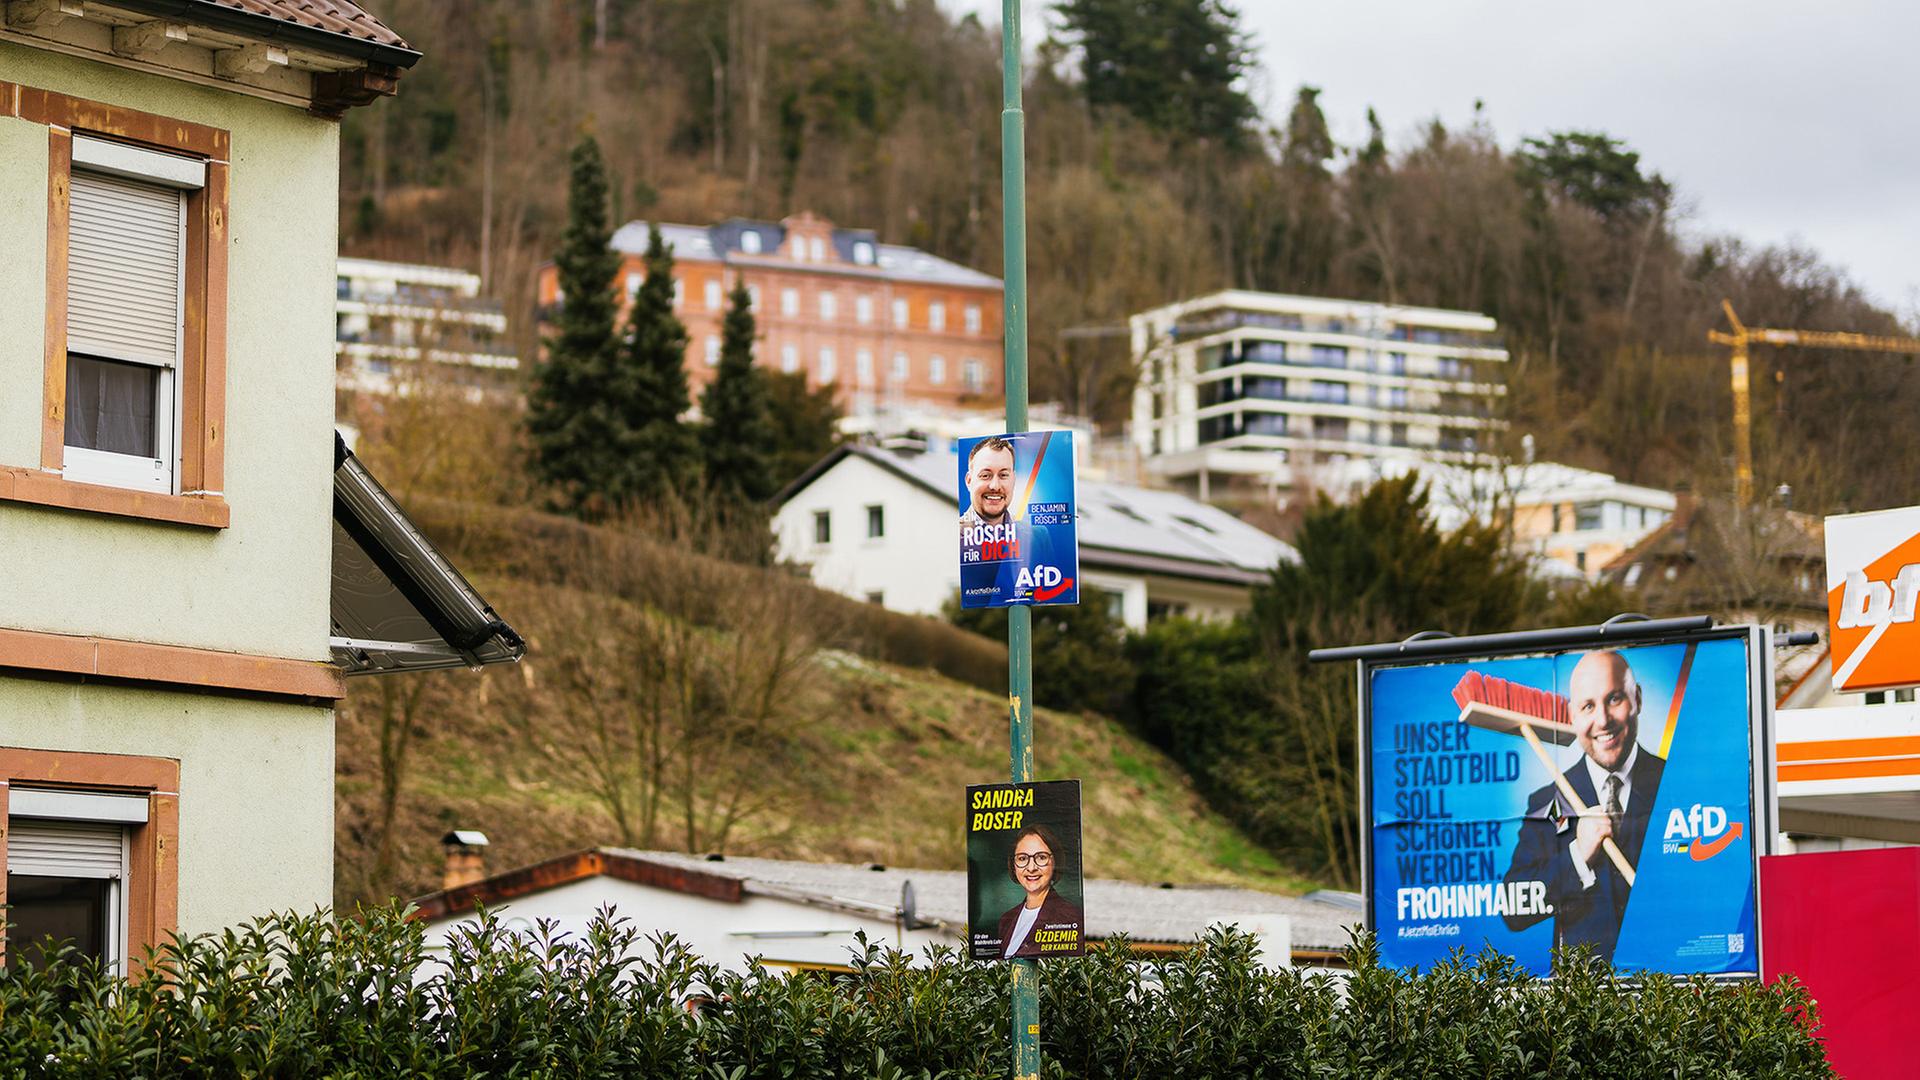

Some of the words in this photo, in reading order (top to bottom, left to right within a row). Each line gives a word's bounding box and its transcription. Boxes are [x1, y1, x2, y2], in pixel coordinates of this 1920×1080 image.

[1031, 503, 1066, 513] BENJAMIN
[1034, 514, 1058, 525] RÖSCH
[963, 522, 1017, 546] RÖSCH
[963, 549, 980, 562] FÜR
[981, 540, 1020, 561] DICH
[1015, 565, 1062, 587] AfD
[1394, 720, 1470, 755] UNSER
[1394, 751, 1520, 788] STADTBILD
[972, 788, 1033, 810] SANDRA
[1394, 789, 1453, 822] SOLL
[972, 811, 1024, 832] BOSER
[1663, 803, 1728, 840] AfD
[1395, 821, 1502, 853] SCHÖNER
[1662, 841, 1679, 855] BW
[1397, 850, 1503, 886] WERDEN.
[1397, 880, 1555, 921] FROHNMAIER.
[1034, 929, 1079, 943] ÖZDEMIR
[1397, 923, 1461, 938] #JetztMalEhrlich
[1041, 943, 1053, 952] DER
[1053, 943, 1069, 951] KANN
[1069, 942, 1078, 951] ES
